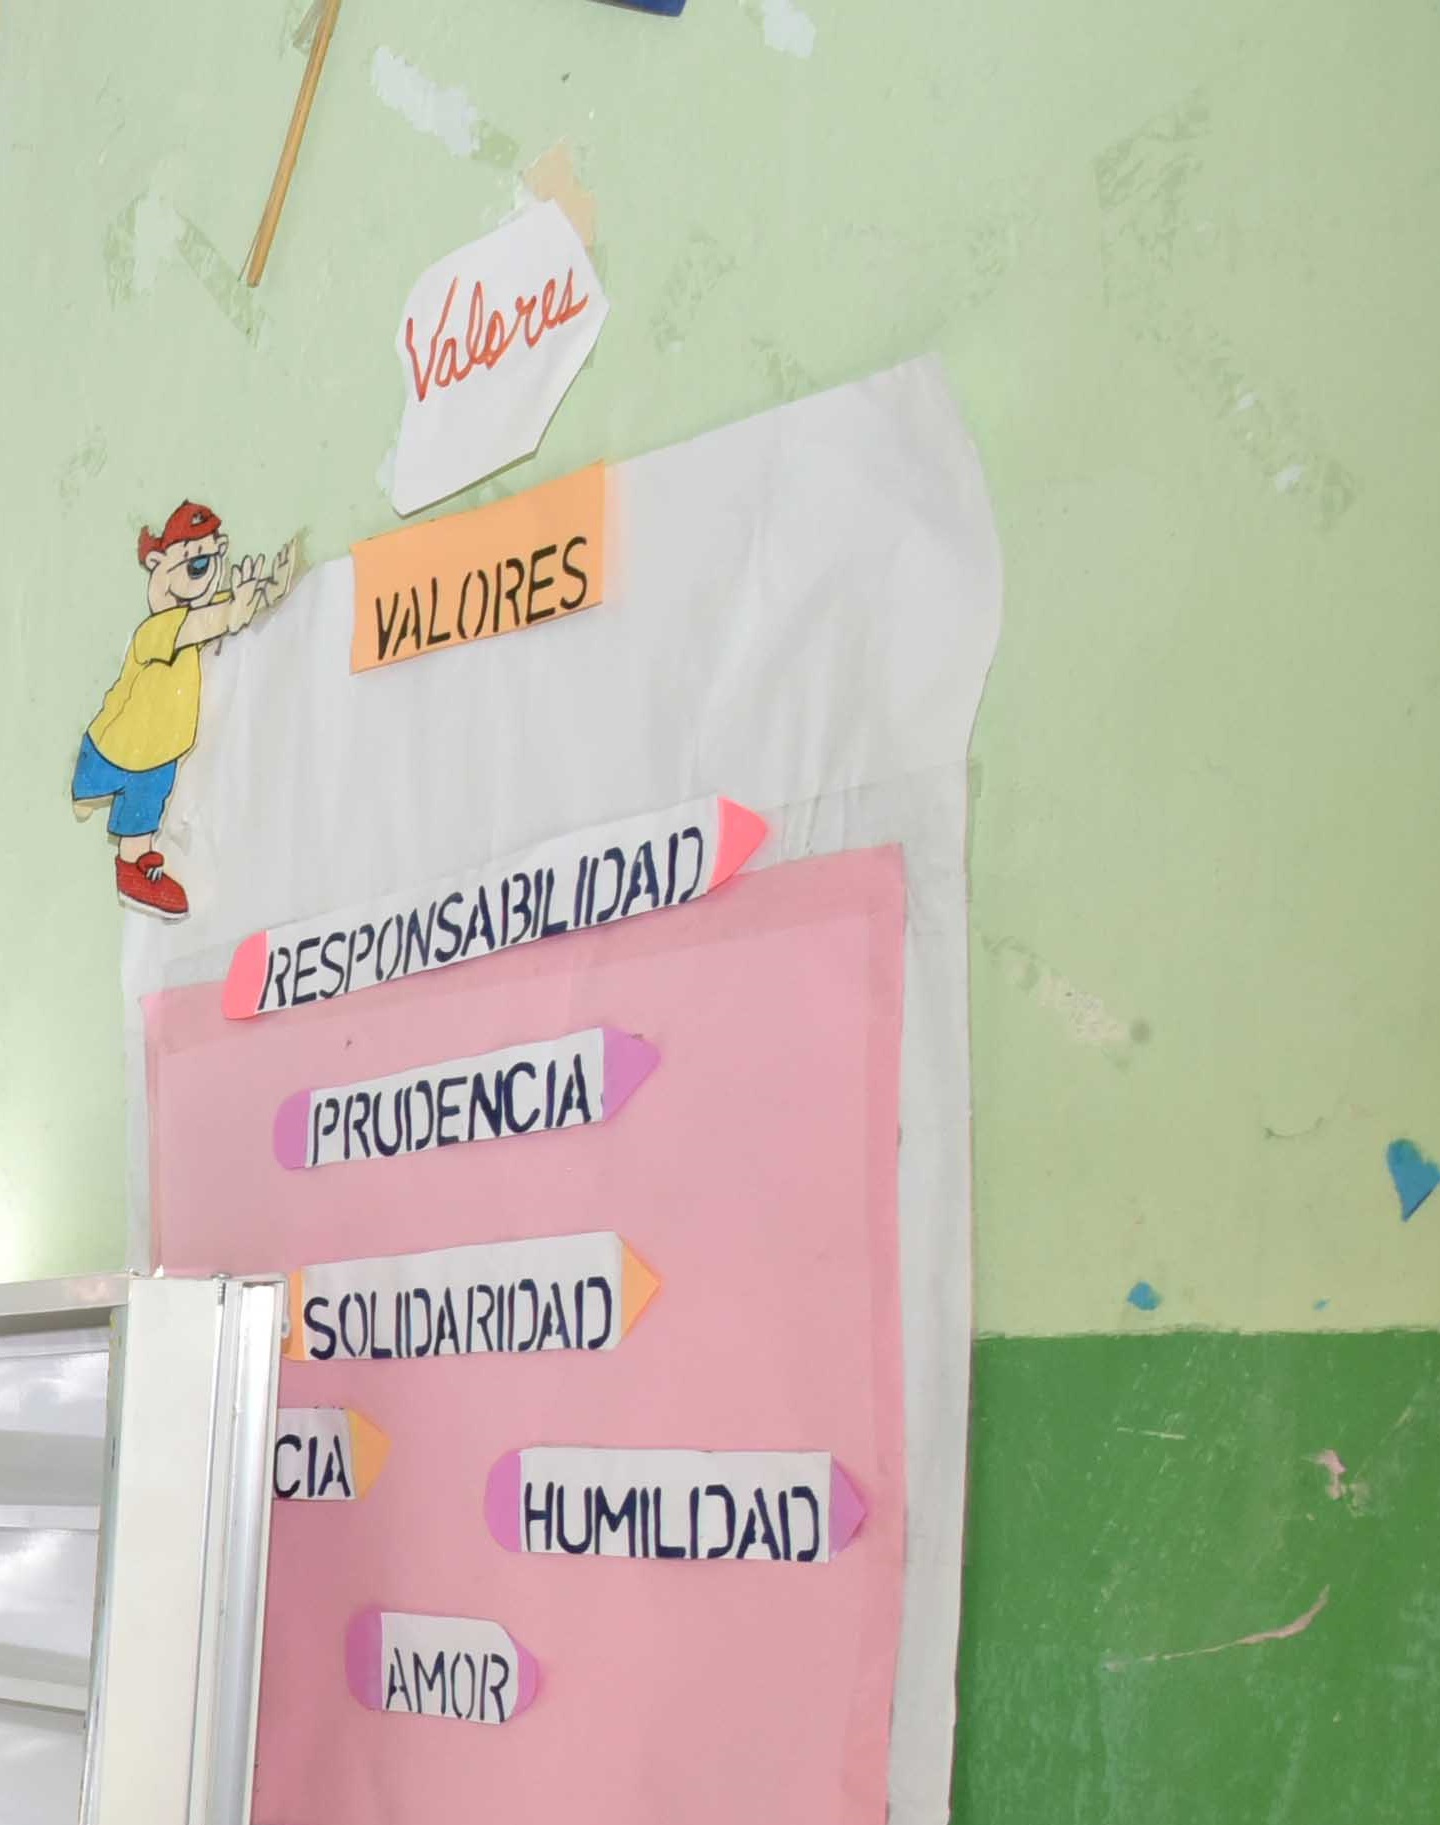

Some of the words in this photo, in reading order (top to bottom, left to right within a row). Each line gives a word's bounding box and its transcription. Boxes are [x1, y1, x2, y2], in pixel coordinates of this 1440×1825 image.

[405, 267, 589, 403] Valores
[375, 535, 588, 661] VALORES
[256, 825, 705, 1011] RESPONSABILIDAD
[311, 1052, 593, 1167] PRUDENCIA
[302, 1275, 613, 1361] SOLIDARIDAD
[272, 1433, 352, 1499] CIA
[524, 1480, 820, 1563] HUMILDAD
[385, 1646, 510, 1724] AMOR
